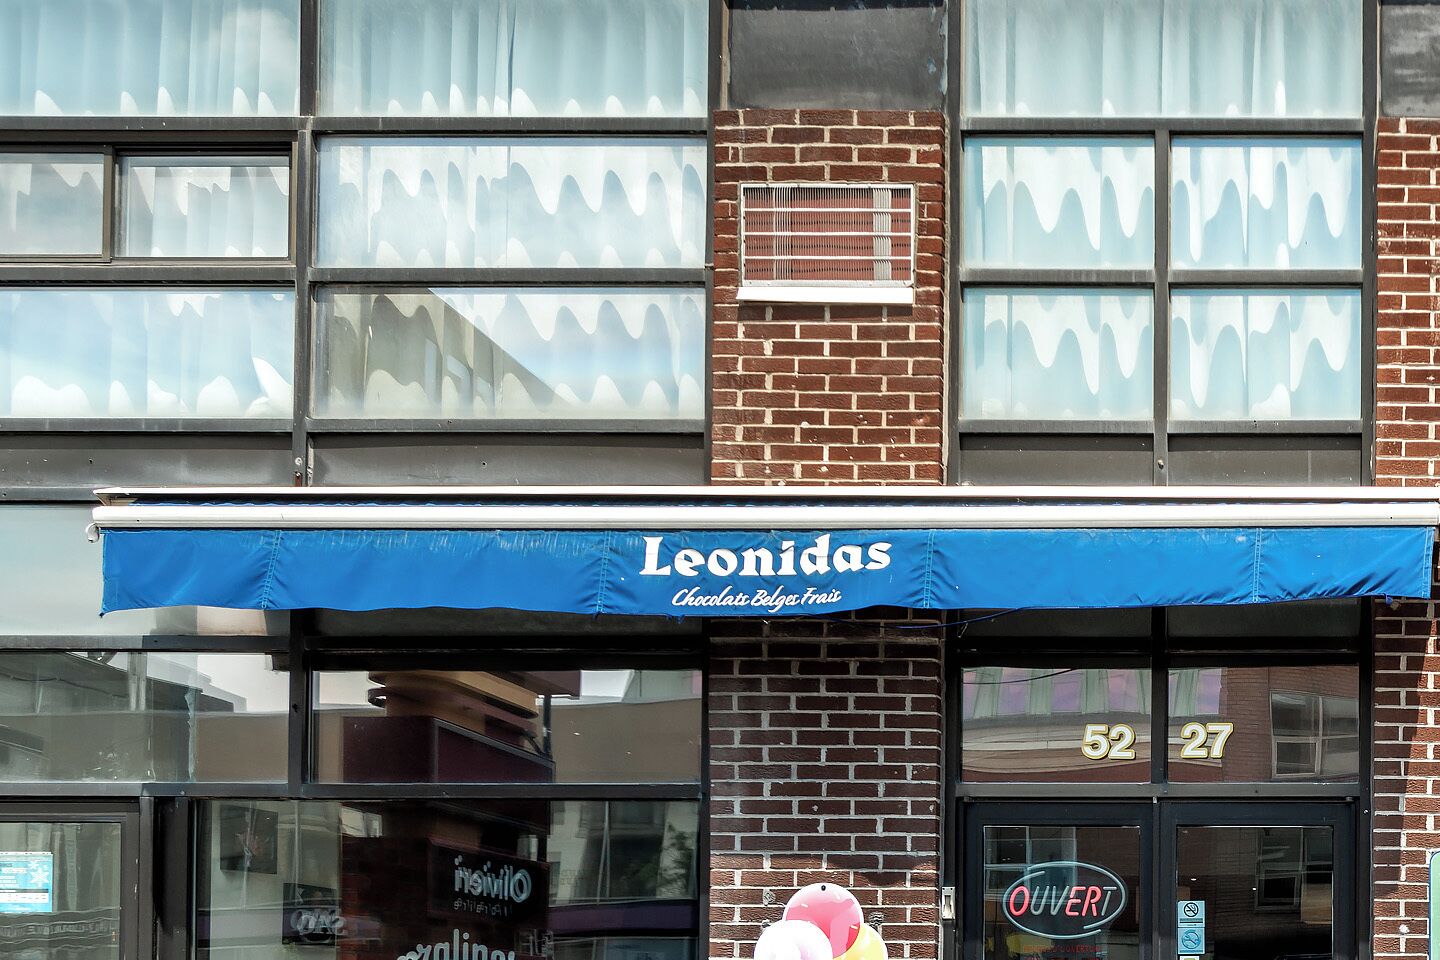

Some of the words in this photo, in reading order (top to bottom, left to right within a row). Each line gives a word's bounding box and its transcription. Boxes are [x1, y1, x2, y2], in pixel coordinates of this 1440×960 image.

[639, 533, 892, 577] Leonidas
[671, 585, 750, 607] Chocolats
[750, 584, 801, 613] Belges
[799, 587, 842, 605] Frais
[1081, 723, 1136, 760] 52
[1180, 721, 1234, 759] 27
[1009, 885, 1117, 916] OUVERT
